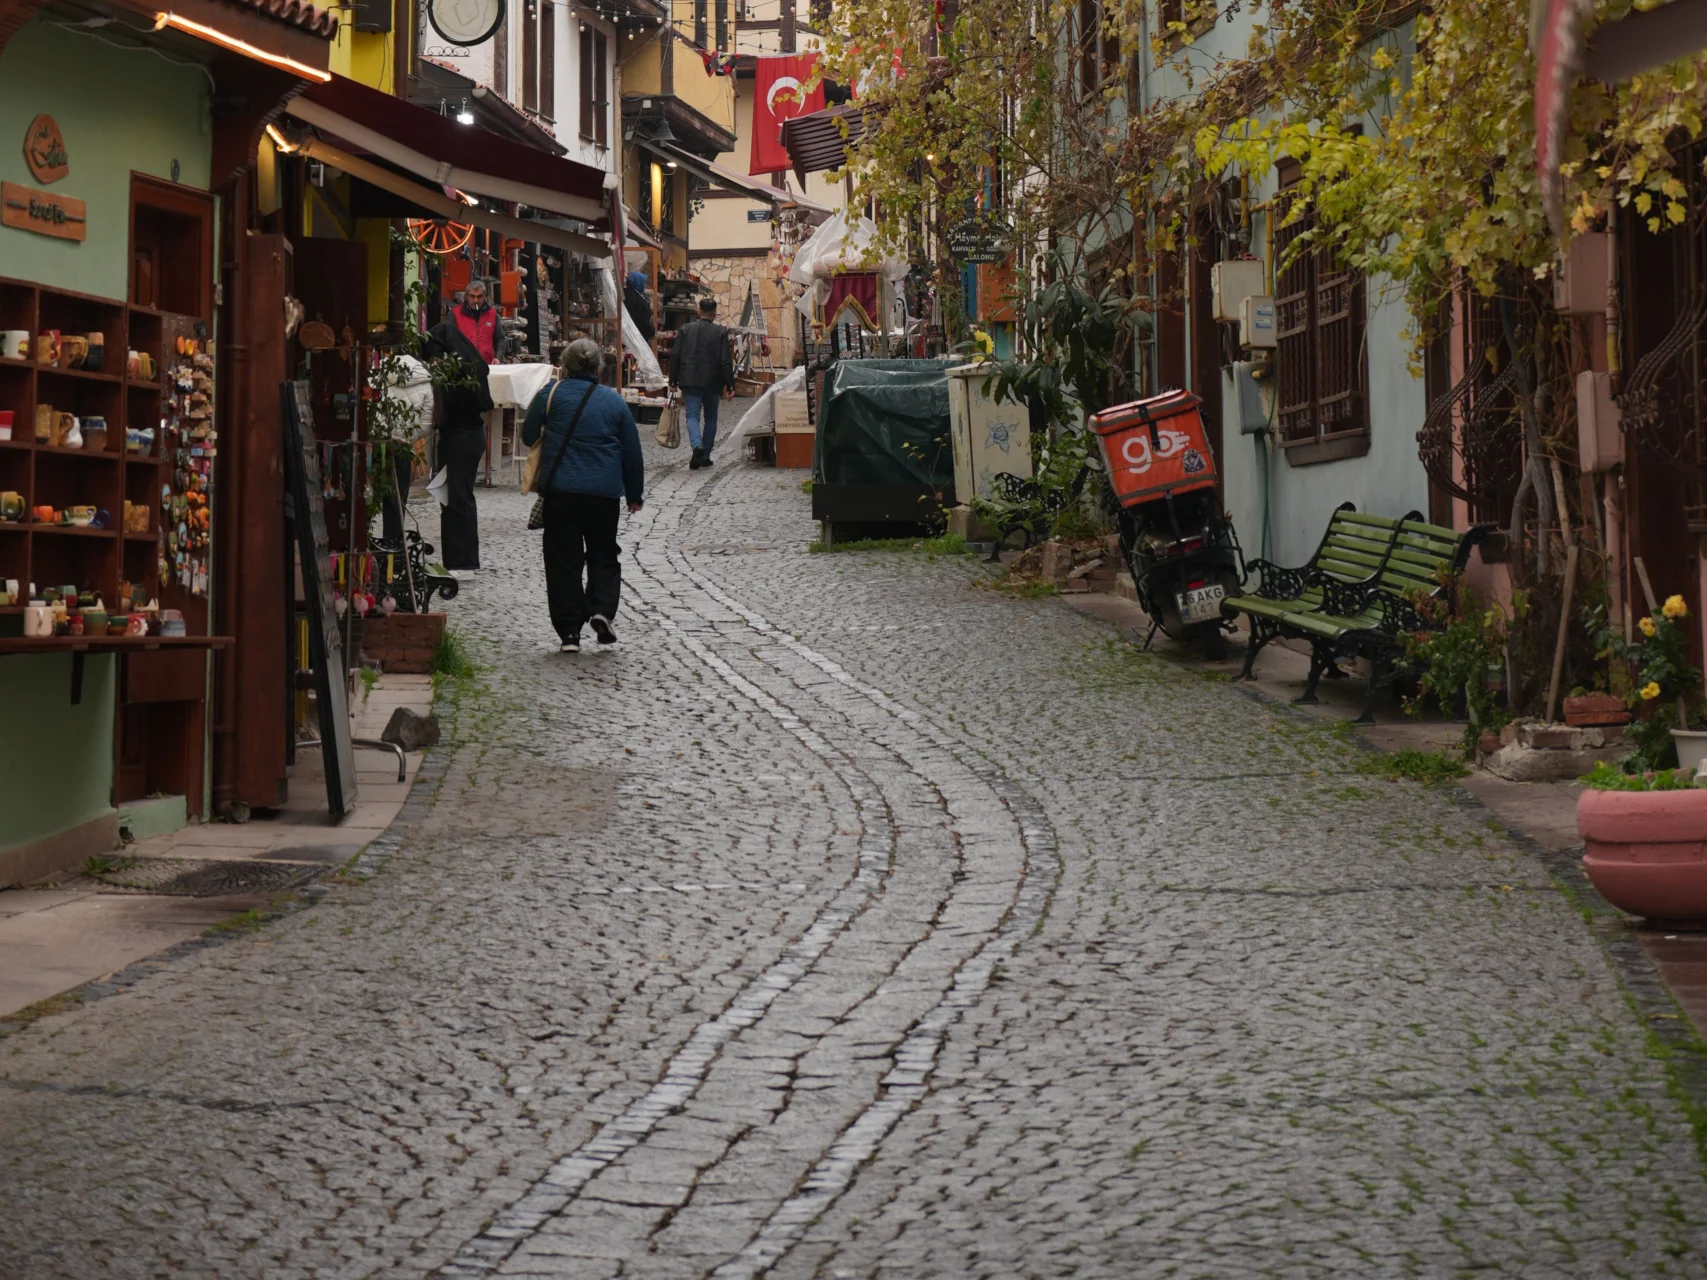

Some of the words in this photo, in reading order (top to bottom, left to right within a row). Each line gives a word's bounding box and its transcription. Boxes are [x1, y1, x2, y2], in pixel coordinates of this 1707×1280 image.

[969, 253, 995, 261] SALONU
[1122, 429, 1190, 474] go
[1197, 587, 1222, 602] AKG
